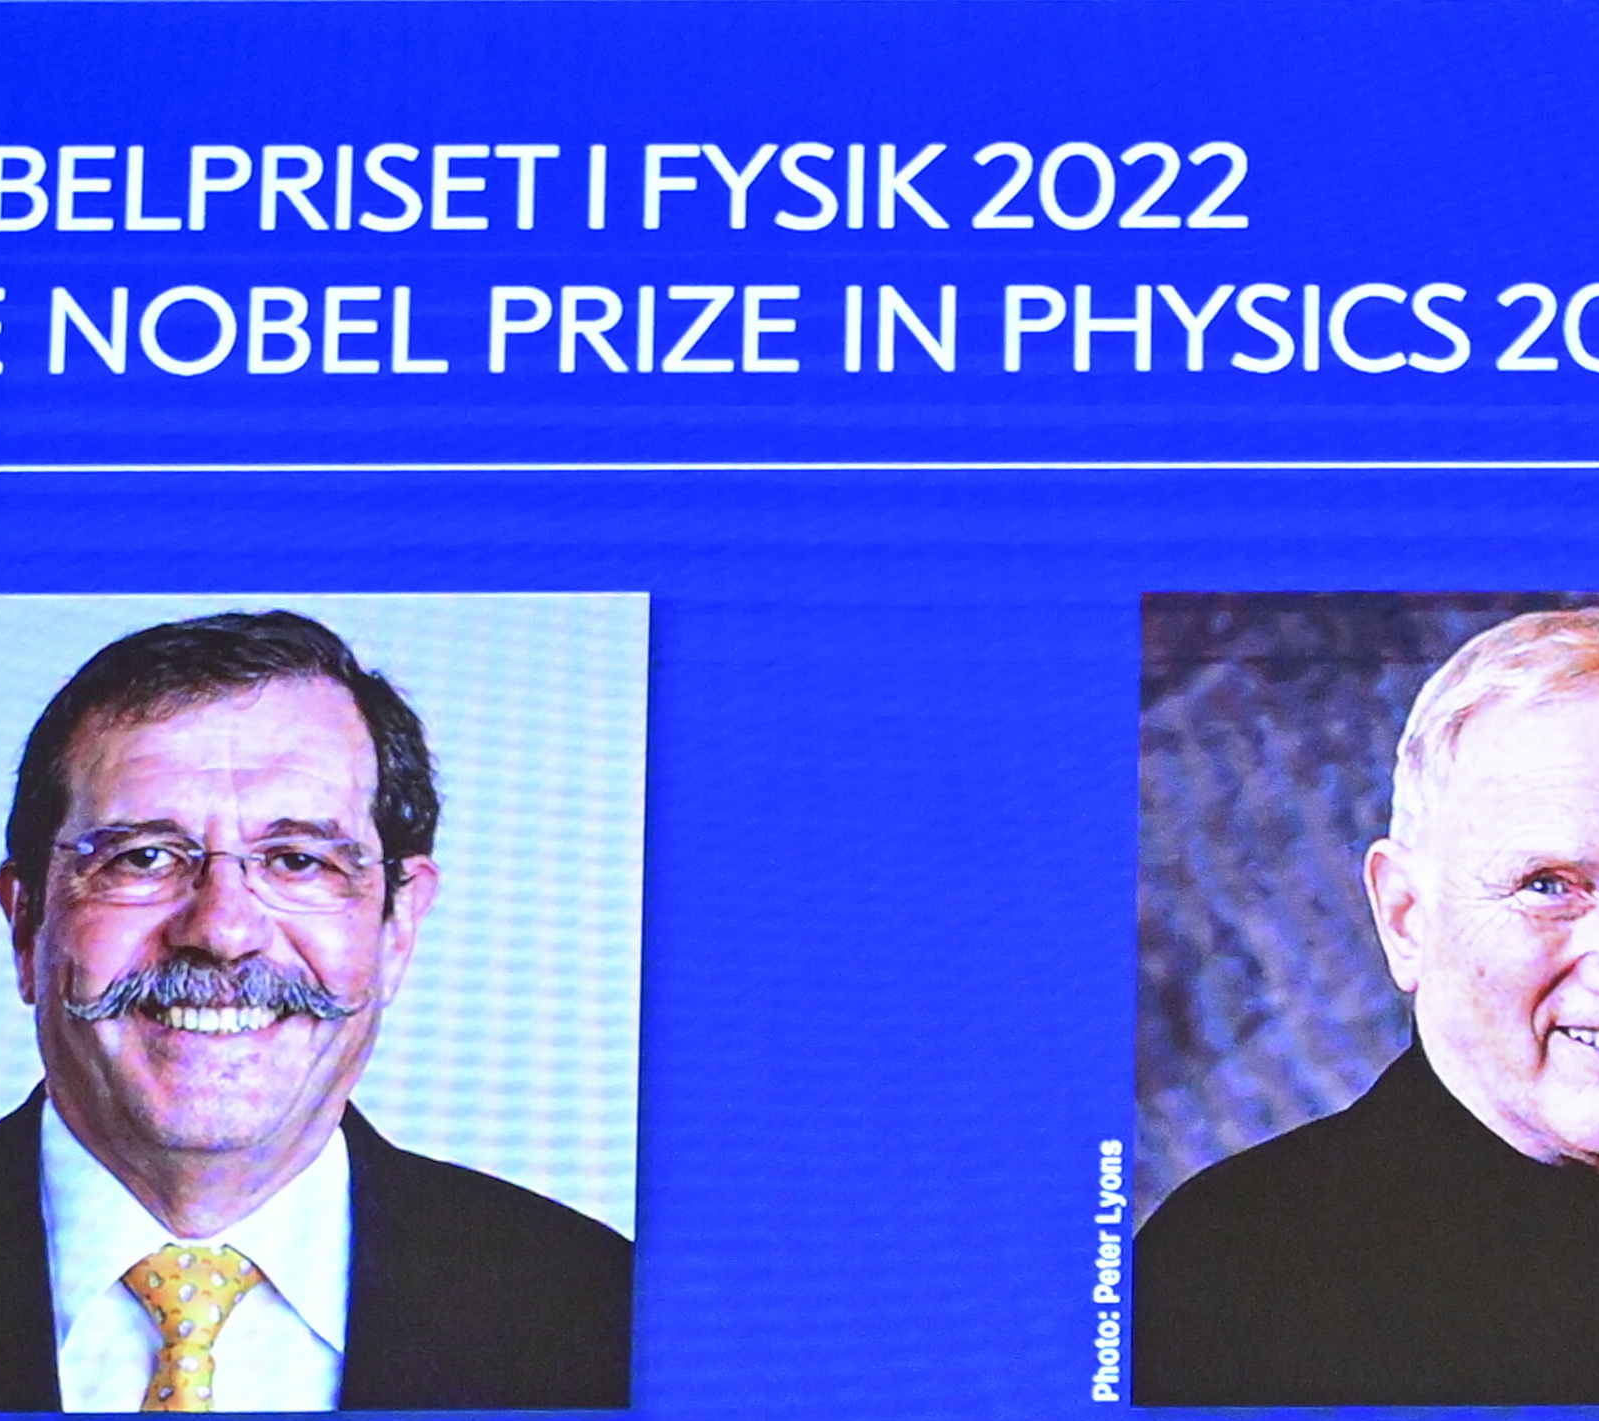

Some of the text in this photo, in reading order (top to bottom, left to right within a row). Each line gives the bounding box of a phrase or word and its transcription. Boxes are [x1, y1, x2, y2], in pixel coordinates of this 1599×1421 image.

[587, 143, 608, 231] I
[642, 141, 951, 232] FYSIK
[971, 140, 1250, 232] 2022
[48, 284, 450, 378] NOBEL
[488, 284, 801, 375] PRIZE
[843, 283, 958, 374] IN
[1003, 281, 1472, 375] PHYSICS
[1090, 1138, 1129, 1403] Photo: Peter Lyons
